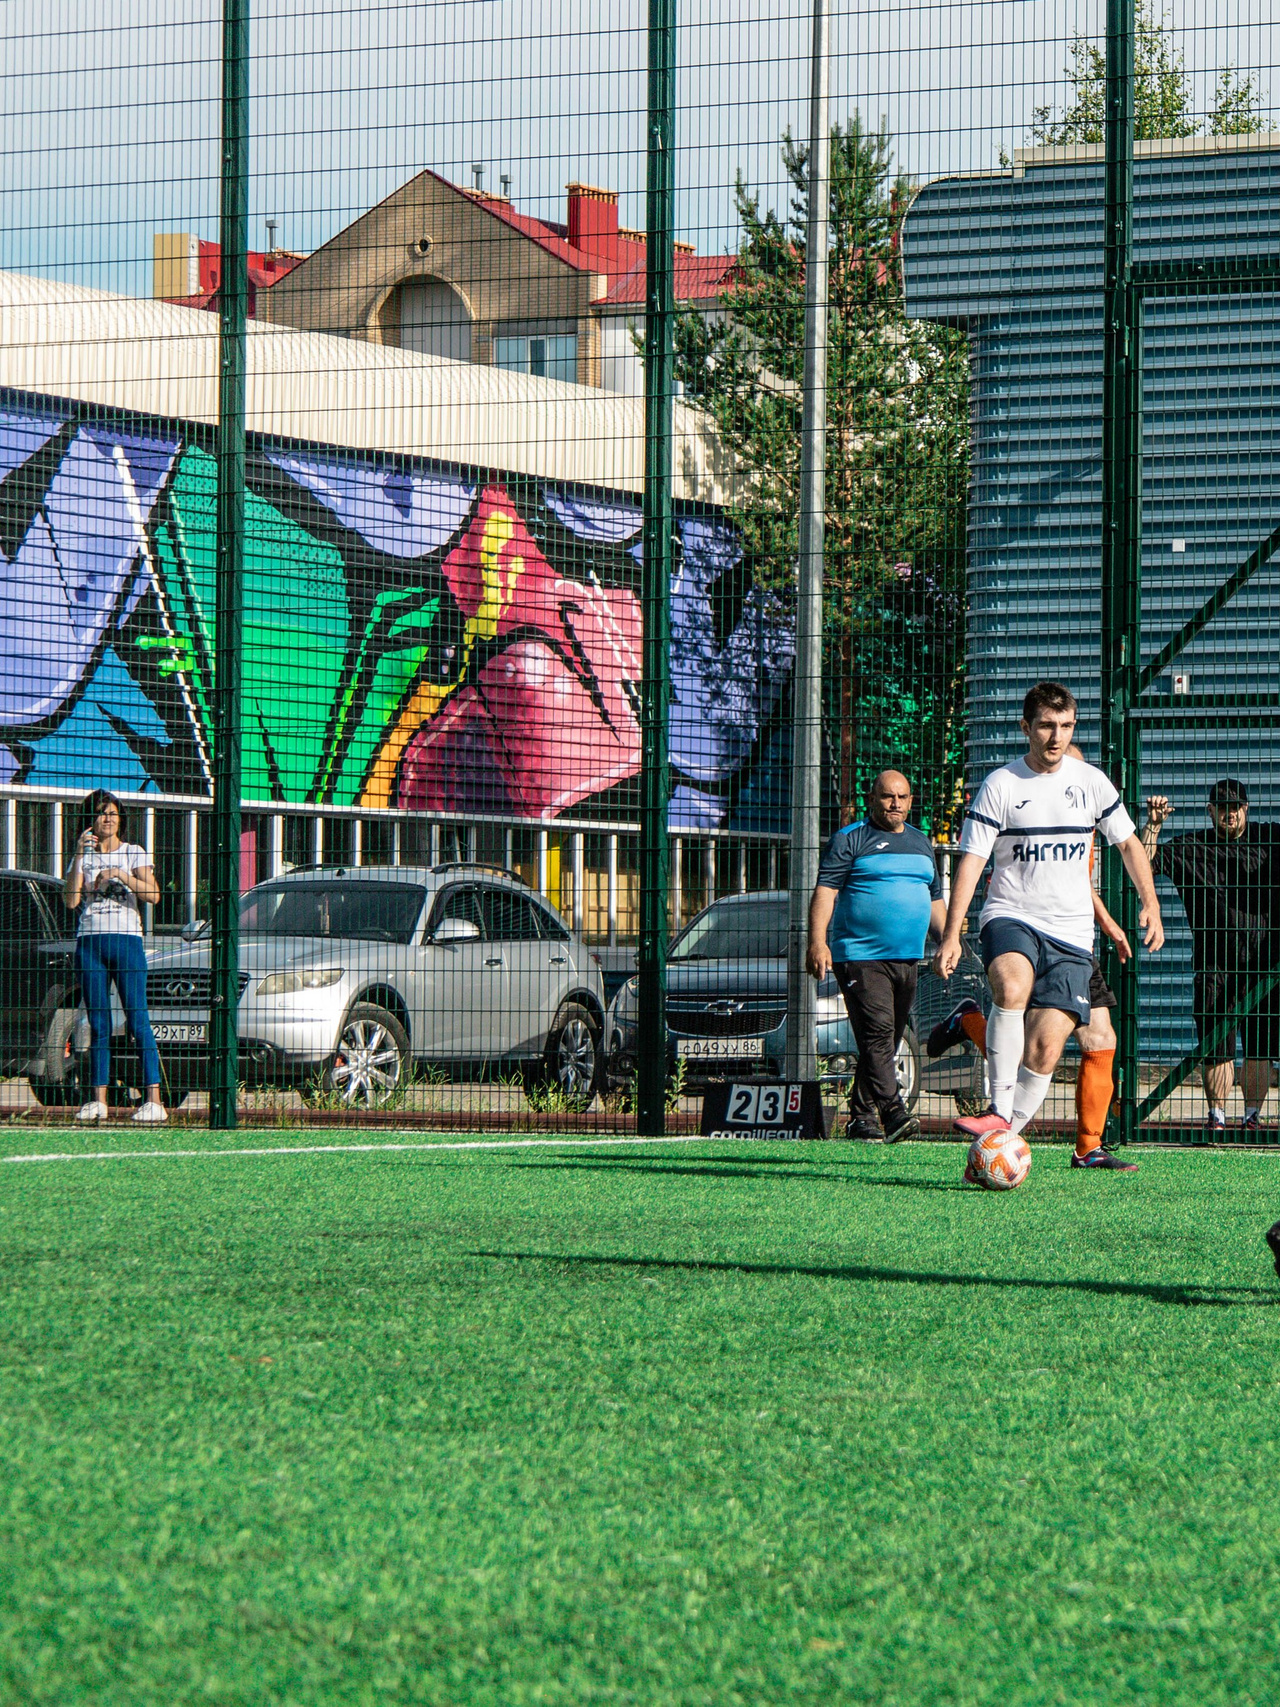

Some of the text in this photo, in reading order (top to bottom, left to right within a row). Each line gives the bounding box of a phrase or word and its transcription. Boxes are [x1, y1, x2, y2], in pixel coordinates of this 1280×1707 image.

[1012, 842, 1086, 862] ЯНГПУР
[152, 1025, 186, 1039] 29ХТ
[742, 1041, 757, 1052] 86
